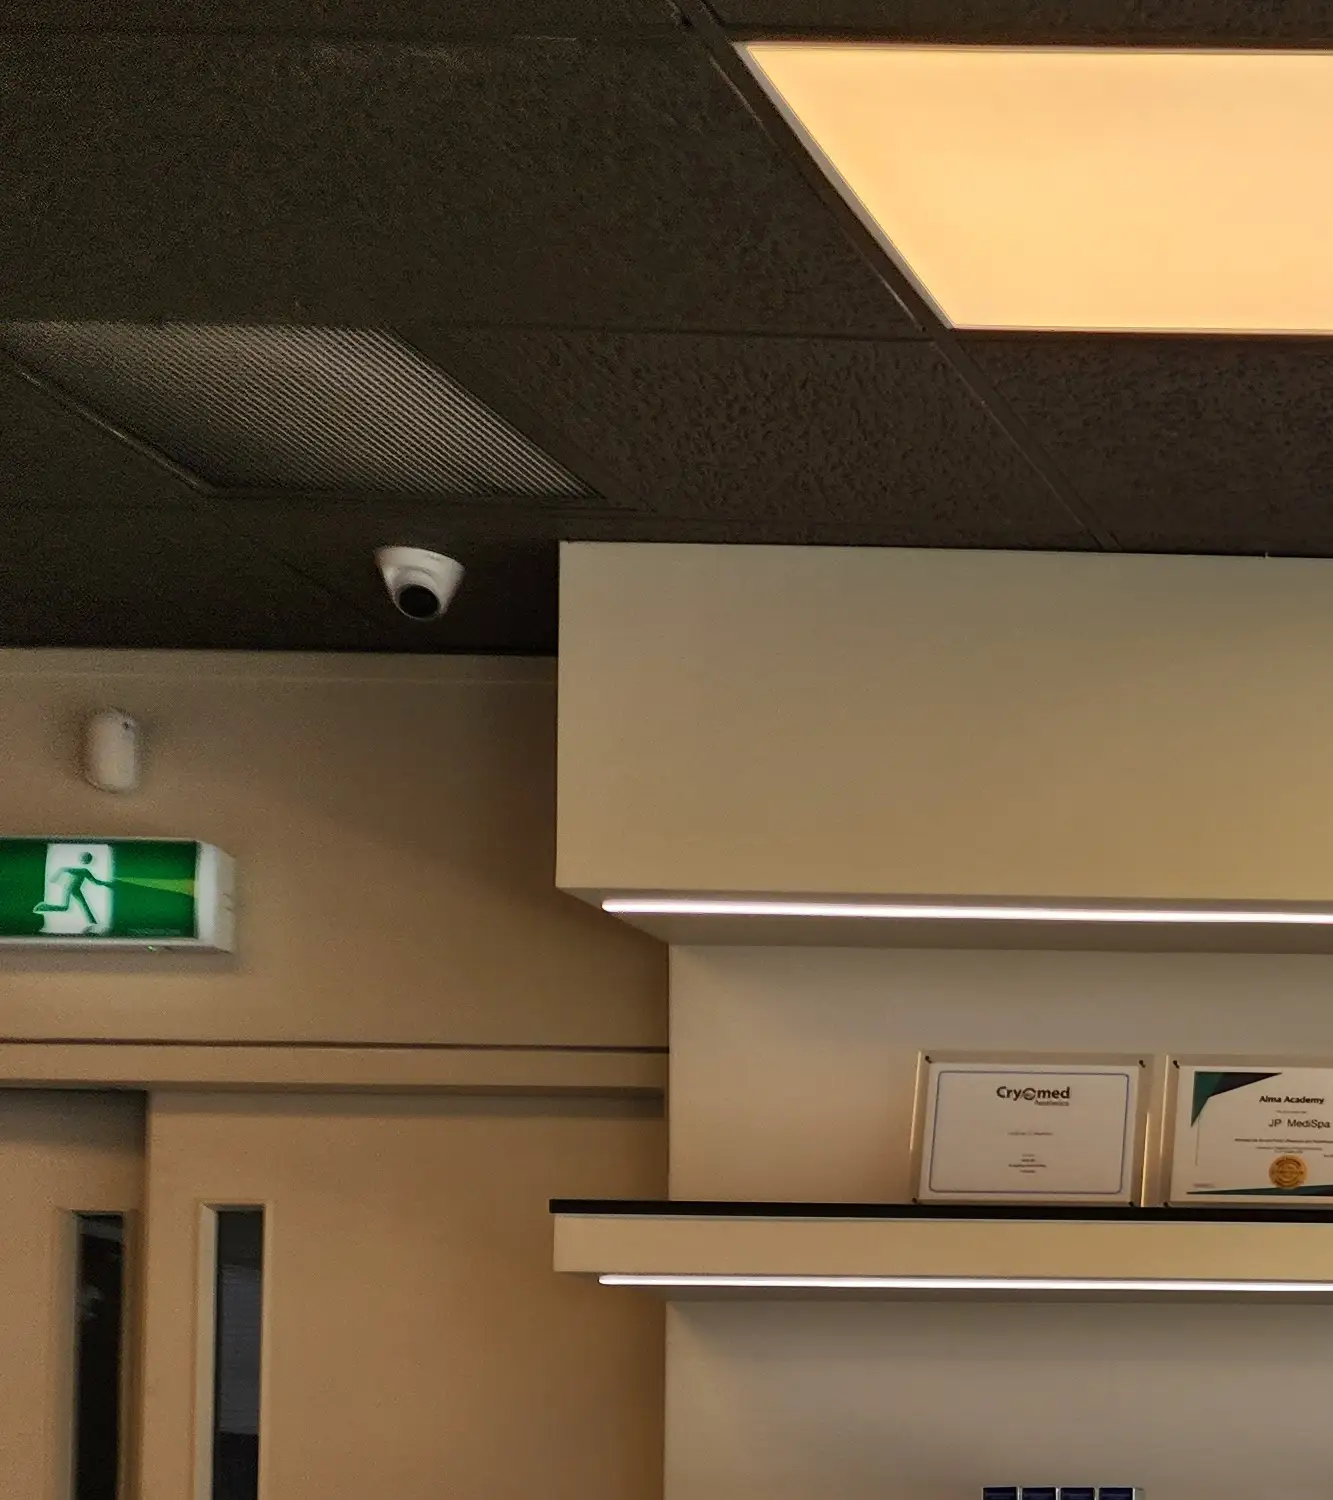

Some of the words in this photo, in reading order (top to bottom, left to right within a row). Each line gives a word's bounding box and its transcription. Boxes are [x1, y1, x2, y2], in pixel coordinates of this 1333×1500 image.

[1284, 1096, 1325, 1104] Academy
[1268, 1119, 1282, 1127] JP
[1287, 1119, 1331, 1129] MediSpa
